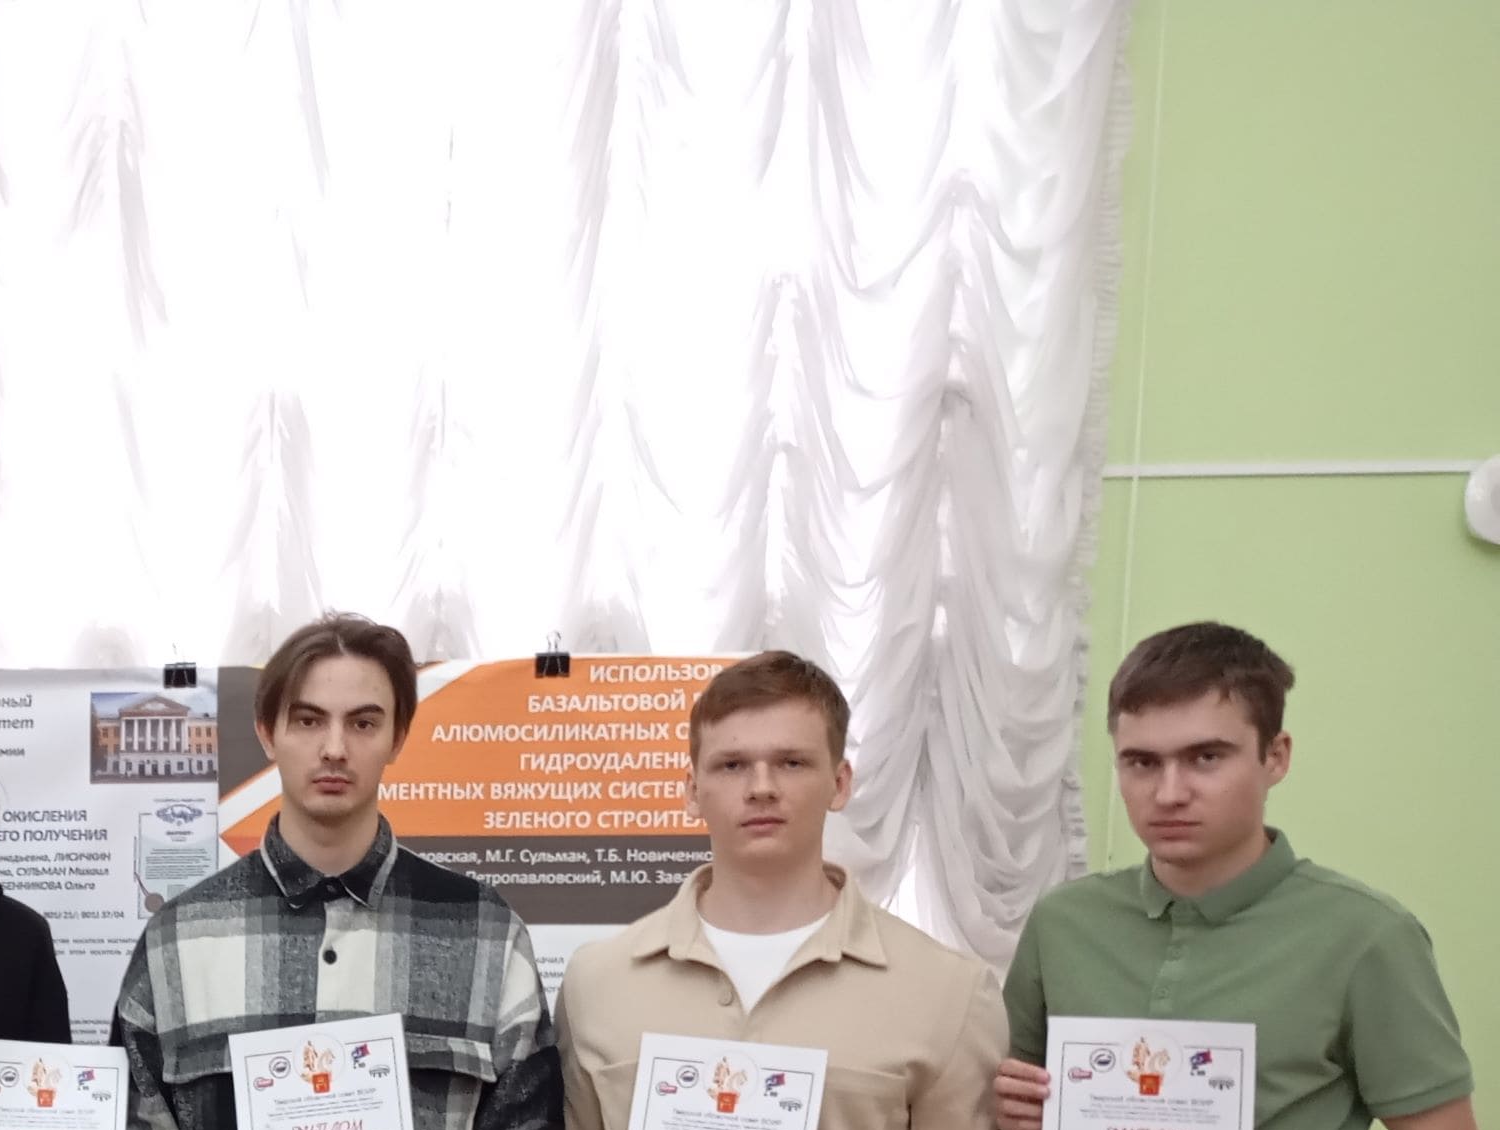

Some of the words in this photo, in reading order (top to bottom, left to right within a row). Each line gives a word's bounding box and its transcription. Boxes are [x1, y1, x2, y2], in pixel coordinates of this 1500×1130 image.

[527, 689, 686, 713] БАЗАЛЬТОВОЙ
[431, 722, 669, 743] АЛЮМОСИЛИКАТНЫХ
[490, 781, 602, 804] ВЯЖУЩИХ
[2, 810, 87, 823] ОКИСЛЕНИЯ
[484, 810, 591, 829] ЗЕЛЕНОГО
[23, 829, 108, 842] ПОЛУЧЕНИЯ
[485, 850, 516, 863] М.Г.
[519, 849, 591, 866] Сульман,
[595, 849, 622, 862] Т.Б.
[610, 870, 651, 884] М.Ю.
